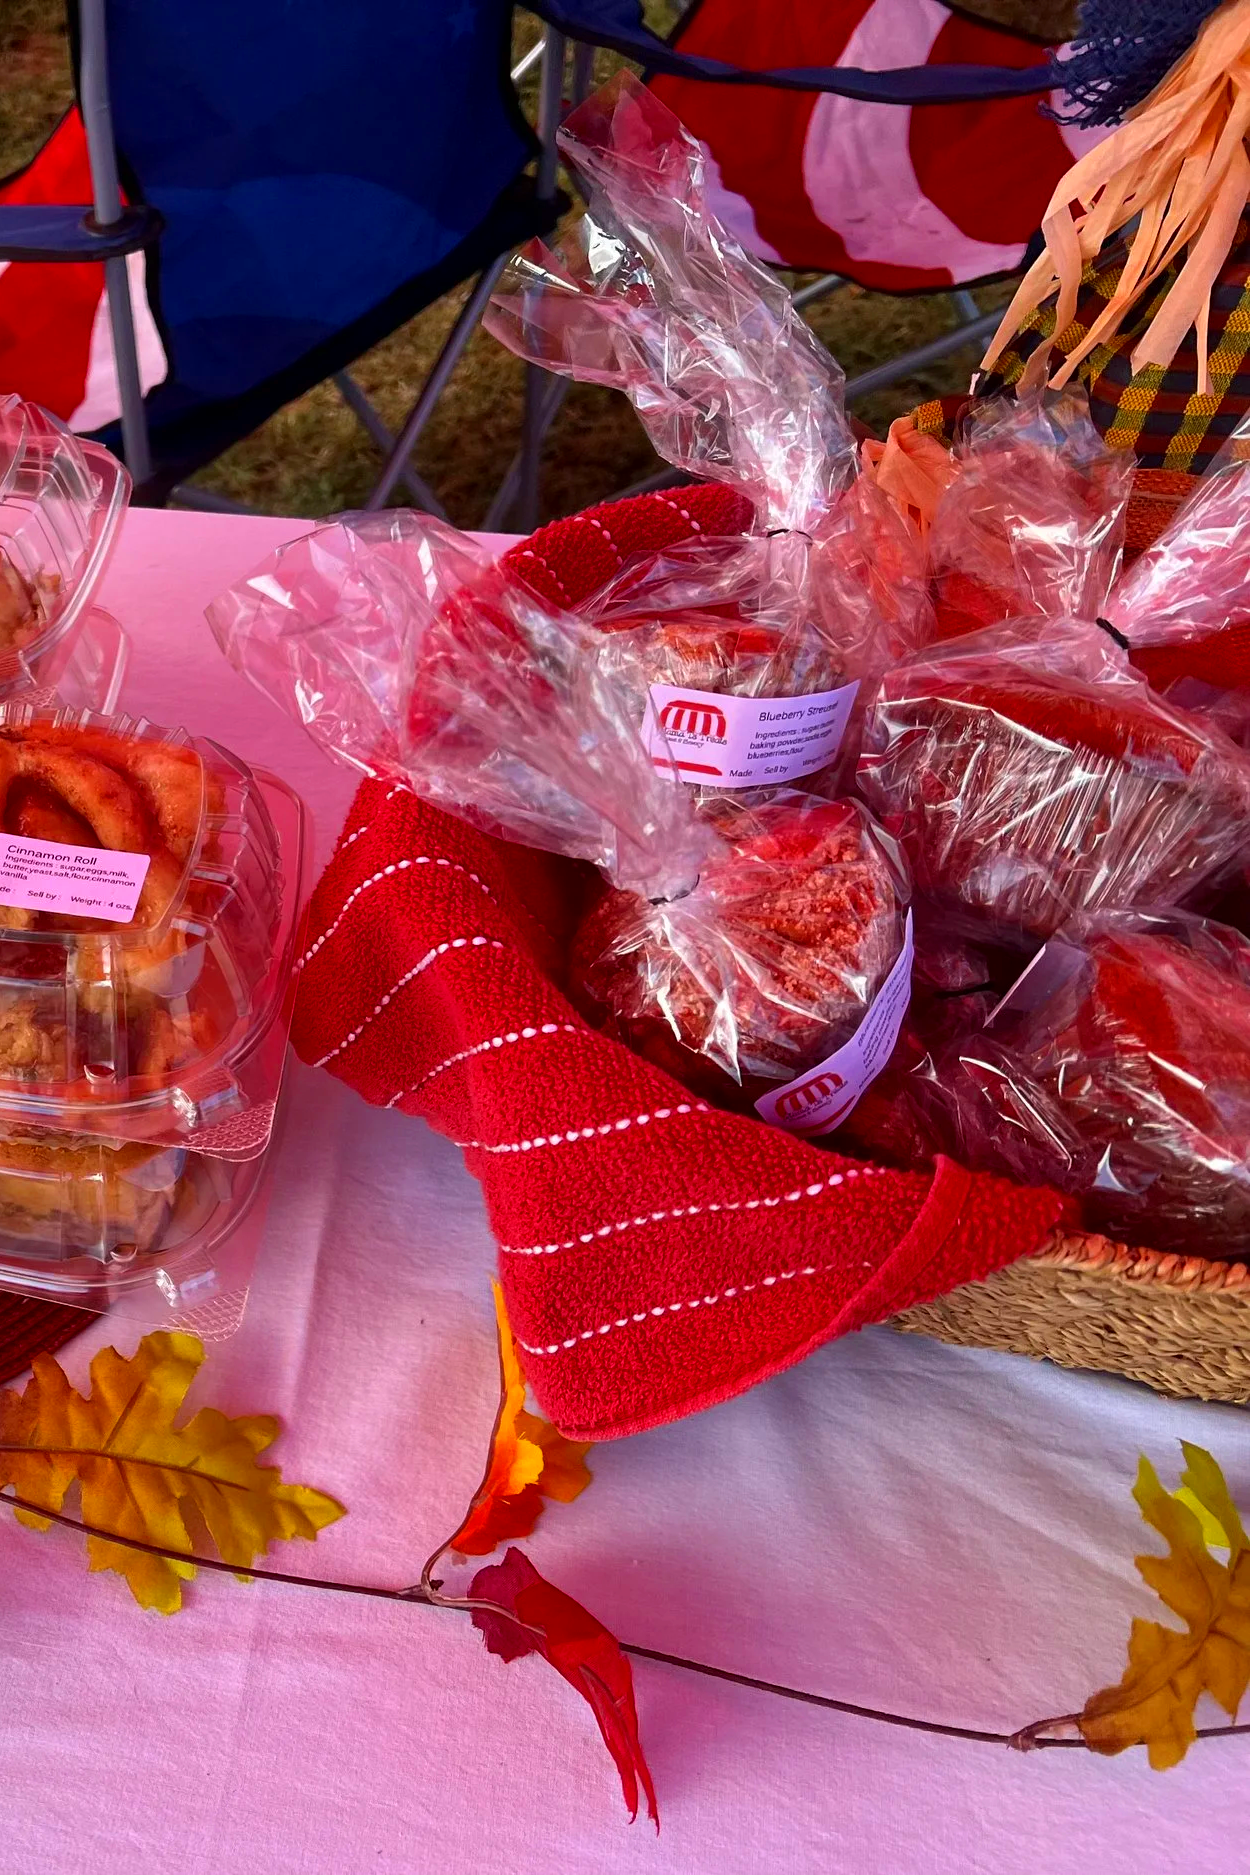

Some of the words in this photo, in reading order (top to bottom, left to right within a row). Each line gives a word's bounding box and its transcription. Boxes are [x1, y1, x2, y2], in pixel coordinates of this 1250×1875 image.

[759, 710, 805, 722] Blueberry
[755, 729, 797, 740] Ingredients
[750, 741, 775, 750] baking
[729, 769, 753, 777] Made
[764, 766, 778, 774] Sell
[780, 765, 788, 774] by
[5, 854, 53, 868] Ingredients
[7, 845, 70, 862] Cinnamon
[74, 856, 98, 865] Roll
[0, 870, 28, 881] vanilla
[27, 890, 44, 899] Sell
[46, 891, 57, 900] by
[70, 896, 101, 906] Weight
